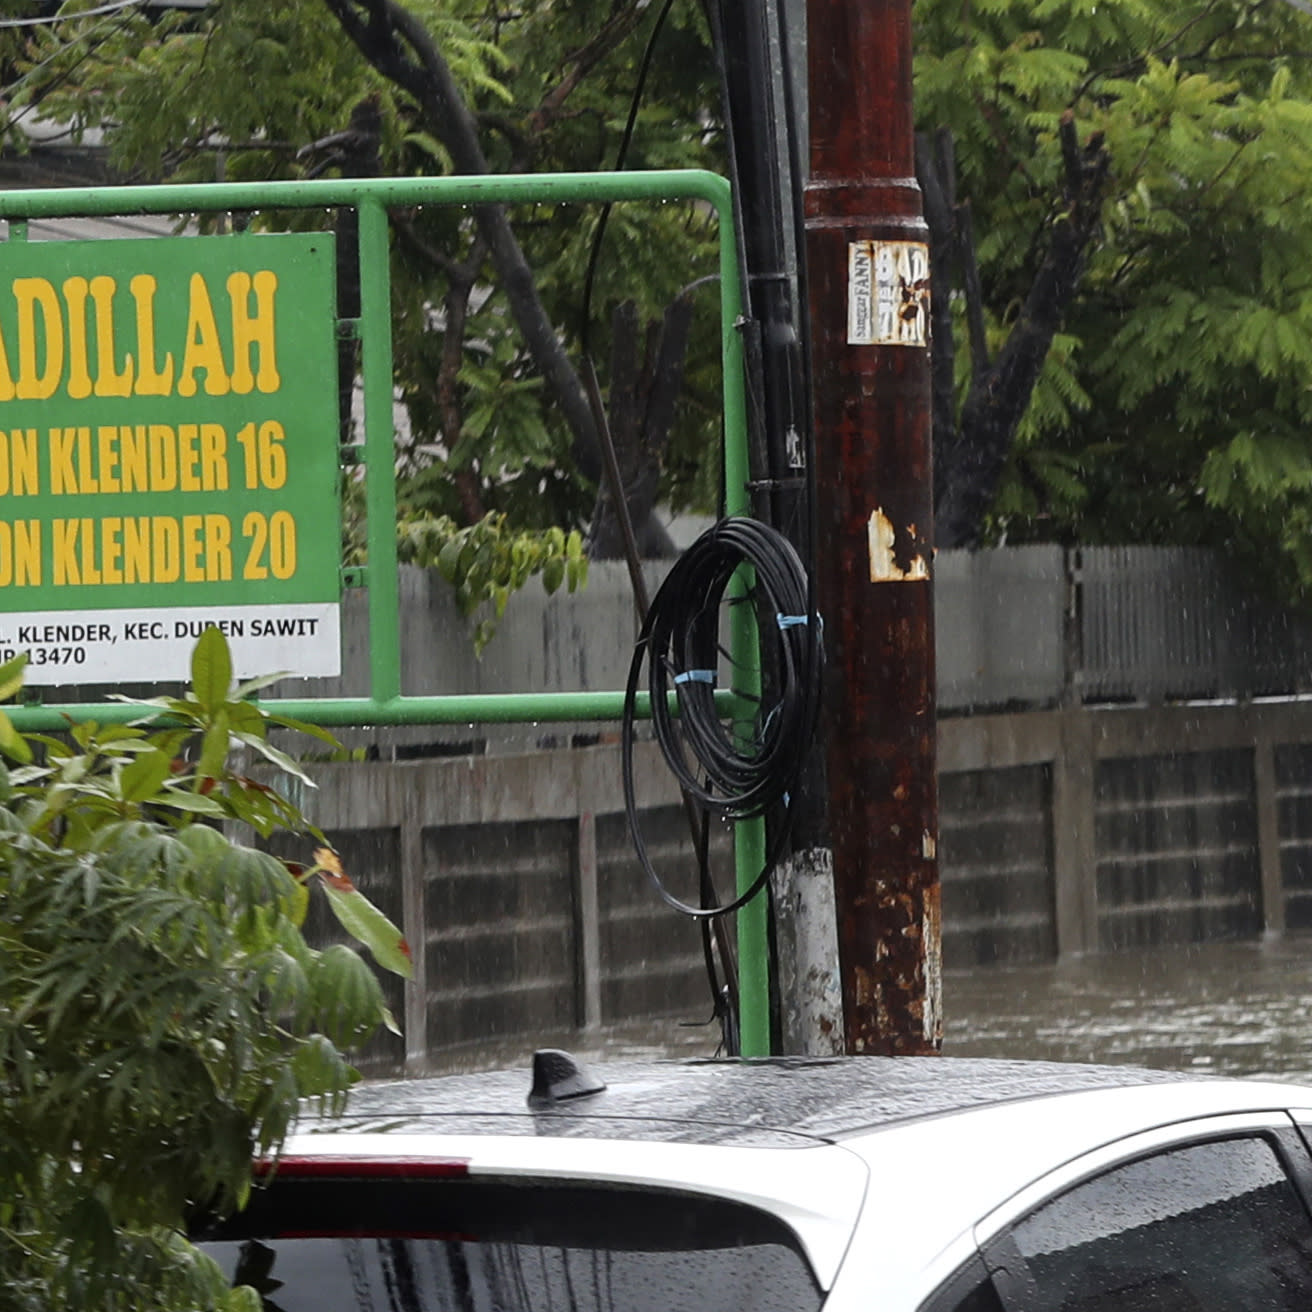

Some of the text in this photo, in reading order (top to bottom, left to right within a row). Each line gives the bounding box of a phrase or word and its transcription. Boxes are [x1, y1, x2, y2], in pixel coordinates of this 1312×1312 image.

[0, 270, 280, 400] DILLAH
[49, 424, 229, 494] KLENDER
[236, 420, 287, 490] 16
[52, 514, 233, 586] KLENDER
[242, 510, 297, 580] 20
[18, 624, 117, 645] KLENDER,
[124, 622, 169, 641] KEC.
[250, 619, 319, 637] SAWIT
[24, 647, 86, 665] 13470
